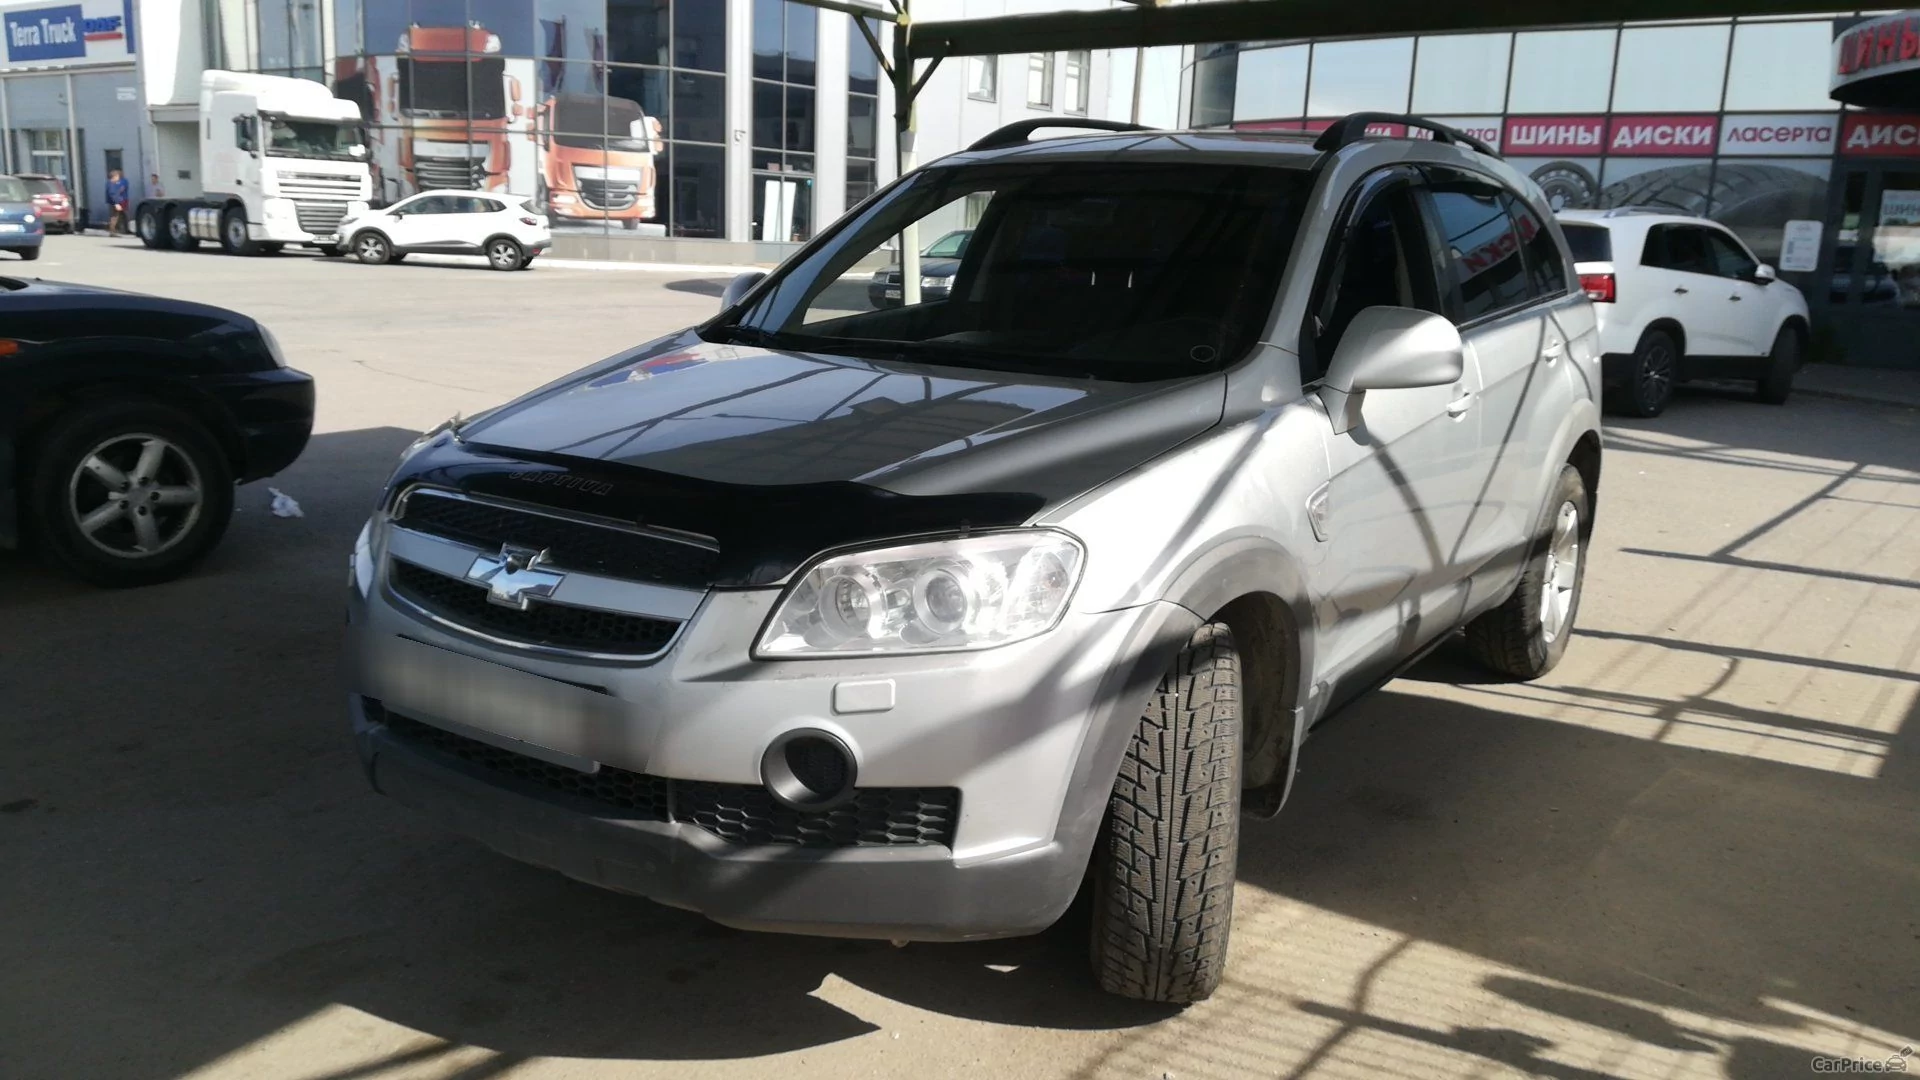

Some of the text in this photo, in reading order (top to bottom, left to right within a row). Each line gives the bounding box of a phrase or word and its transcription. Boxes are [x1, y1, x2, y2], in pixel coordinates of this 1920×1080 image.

[10, 16, 77, 47] Terra Truck
[1510, 124, 1601, 147] ШИНЫ
[1612, 124, 1714, 149] ДИСКИ
[1727, 124, 1832, 143] ласерта
[1847, 123, 1920, 149] ДИС
[508, 470, 614, 496] CAPTIVA
